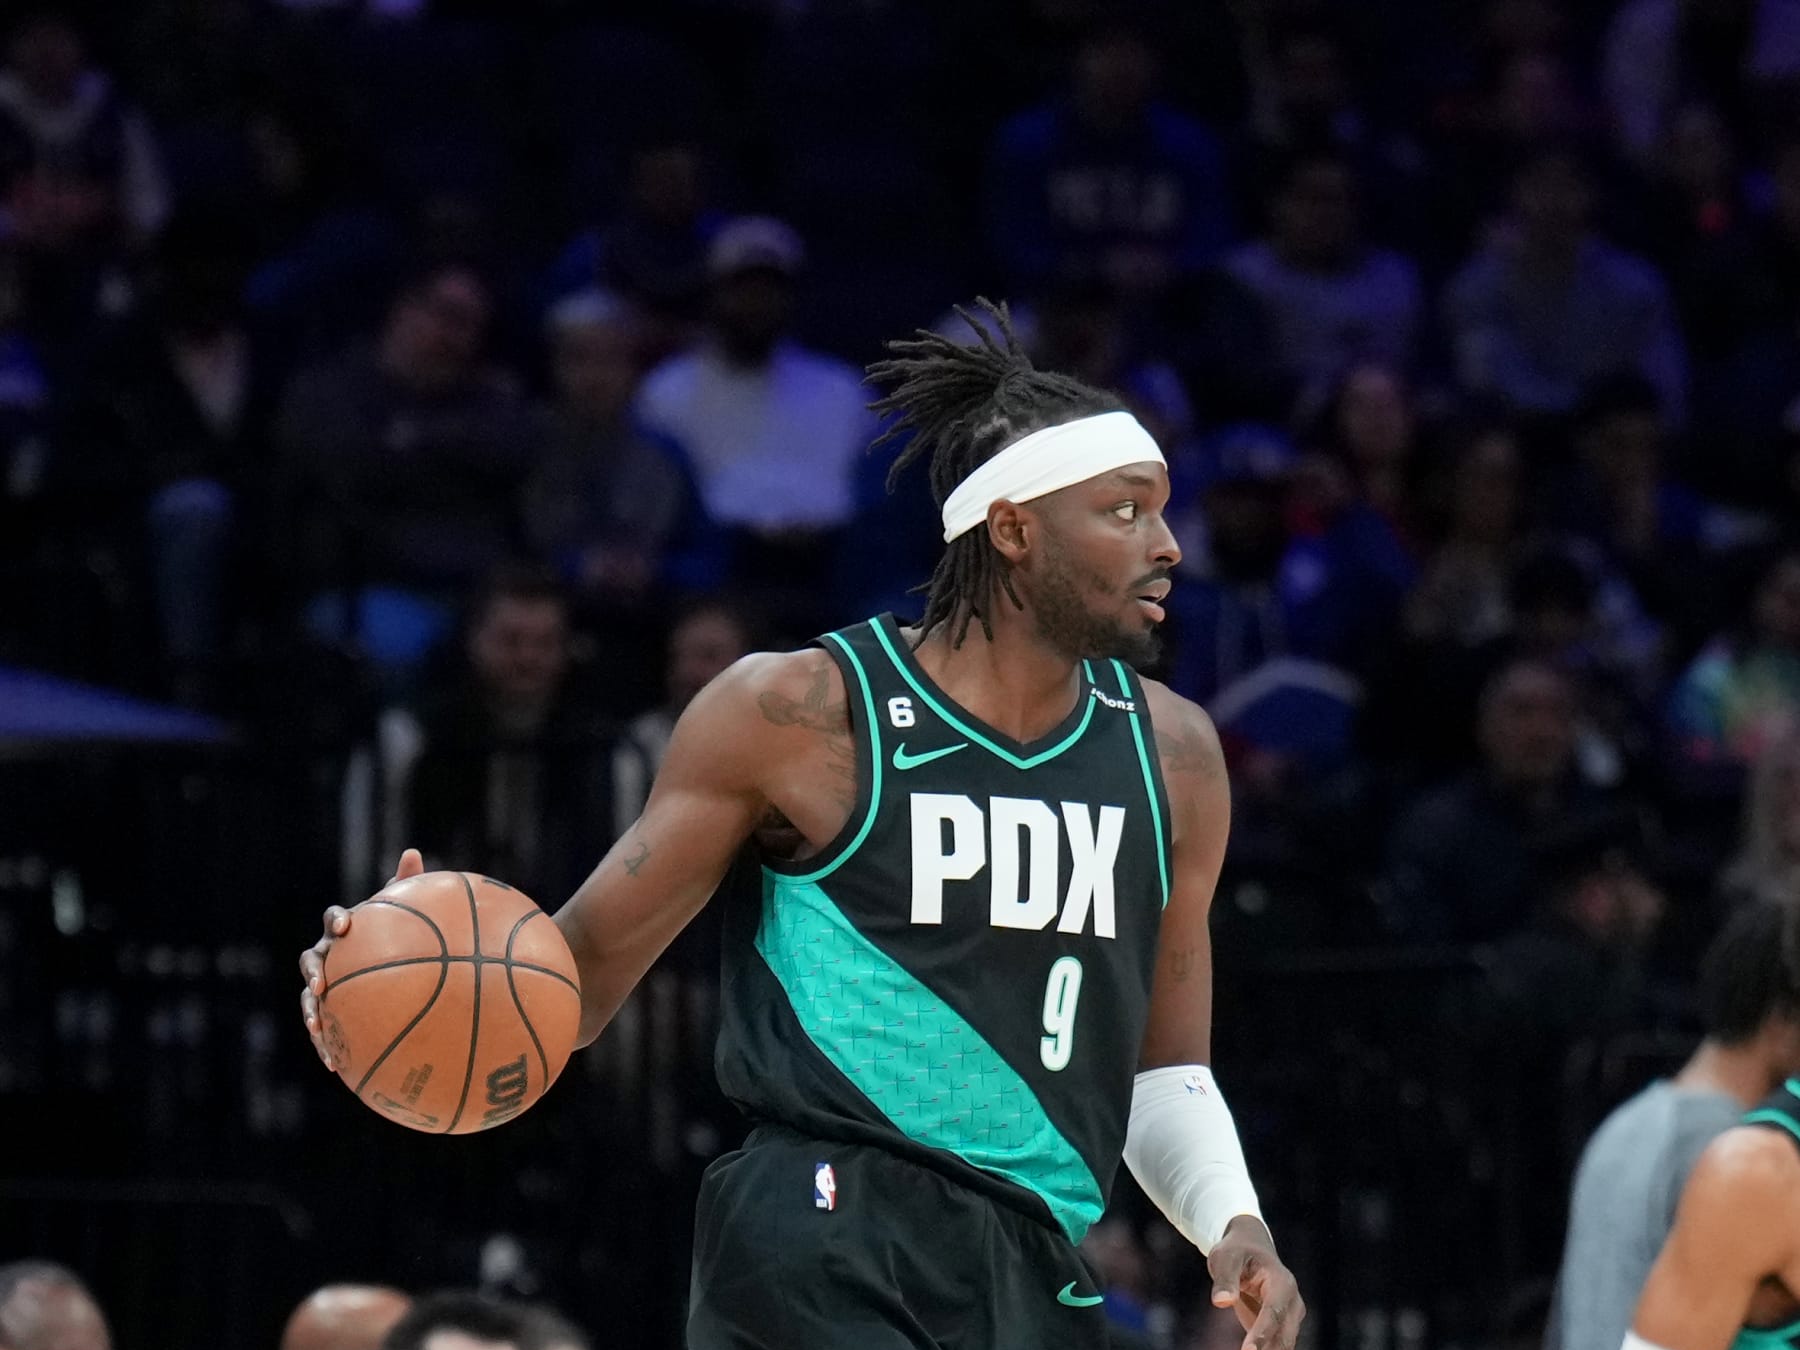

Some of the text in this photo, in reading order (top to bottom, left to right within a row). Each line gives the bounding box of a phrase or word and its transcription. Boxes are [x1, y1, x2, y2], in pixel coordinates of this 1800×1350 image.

[888, 697, 915, 727] 6
[910, 792, 1126, 939] PDX
[1040, 956, 1083, 1071] 9
